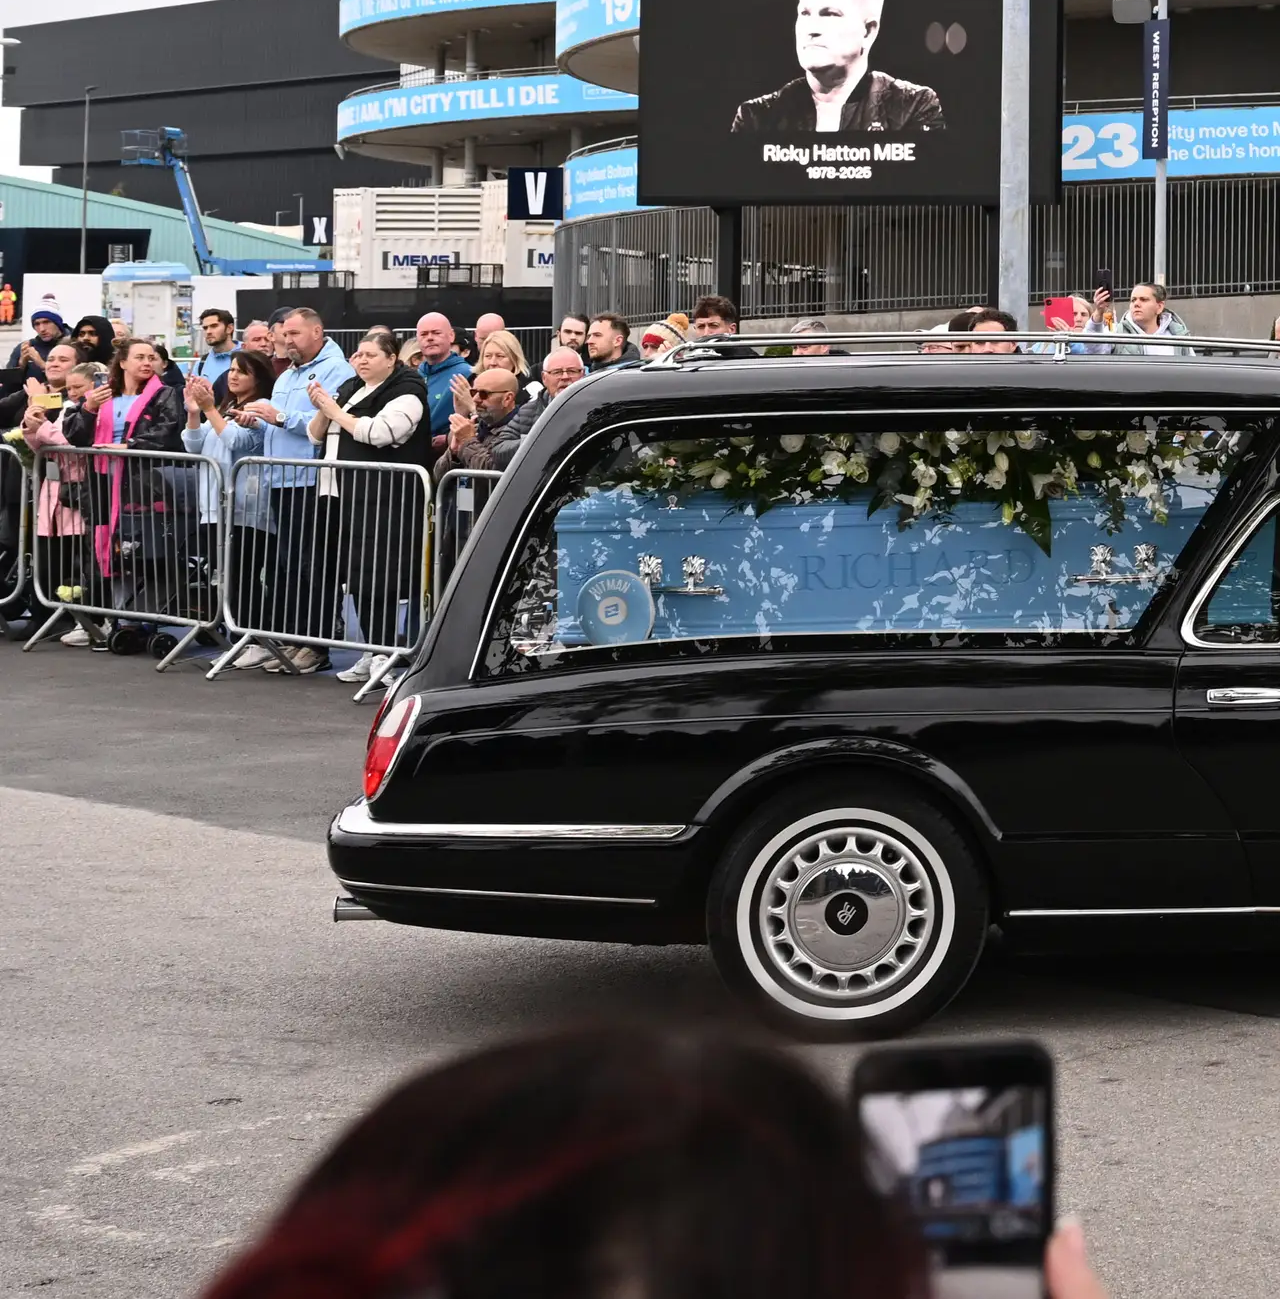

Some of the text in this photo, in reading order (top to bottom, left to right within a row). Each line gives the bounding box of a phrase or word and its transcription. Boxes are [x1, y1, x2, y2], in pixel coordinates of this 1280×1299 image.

[410, 91, 454, 115] CITY
[456, 86, 504, 111] TILL
[517, 83, 559, 106] DIE
[1151, 30, 1161, 148] WEST RECEPTION
[1199, 123, 1248, 138] move
[1250, 120, 1269, 137] to
[762, 142, 916, 166] Ricky Hatton MBE
[805, 166, 873, 180] 1978-2025
[525, 172, 547, 216] V
[312, 216, 328, 244] X
[392, 254, 450, 267] MEMS
[797, 549, 1037, 591] RICHARD
